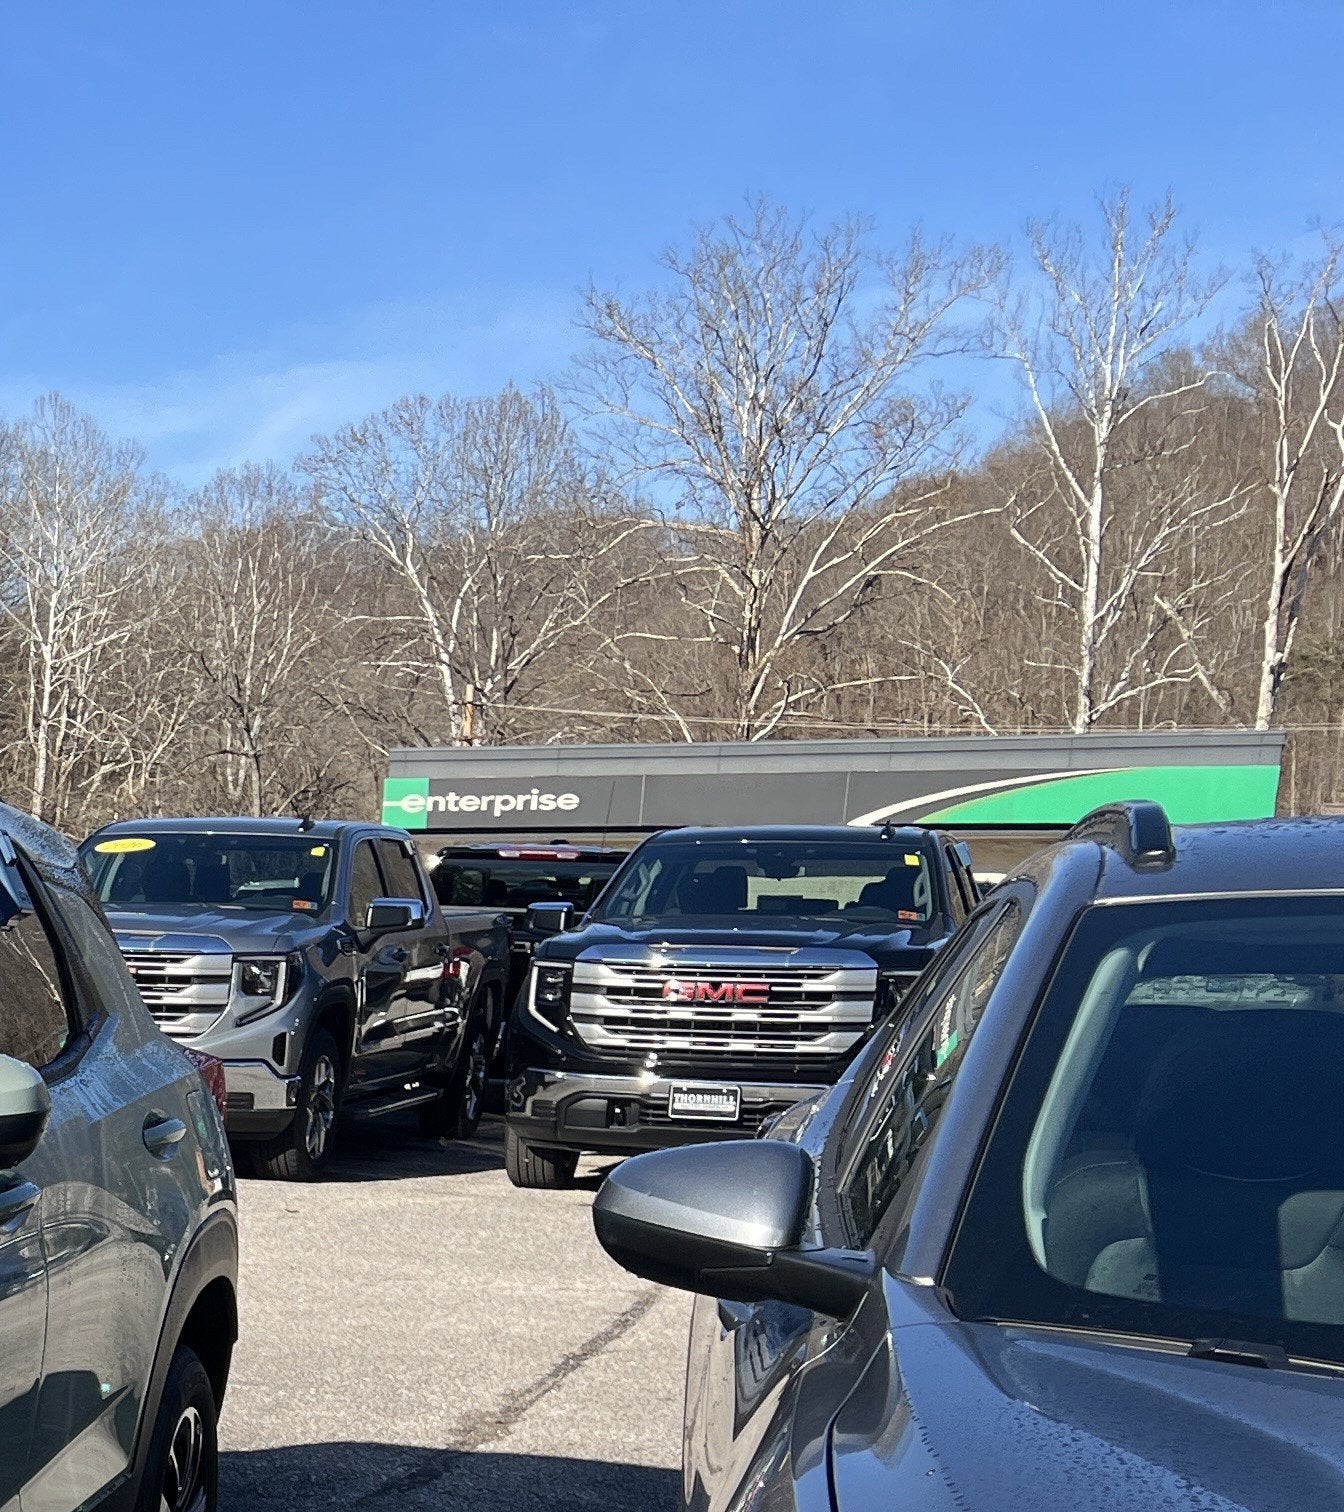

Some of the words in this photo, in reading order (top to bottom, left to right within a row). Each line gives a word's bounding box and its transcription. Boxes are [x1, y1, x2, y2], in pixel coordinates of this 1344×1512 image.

[400, 788, 580, 817] enterprise
[662, 980, 770, 1004] GMC
[673, 1093, 736, 1105] THORNHILL
